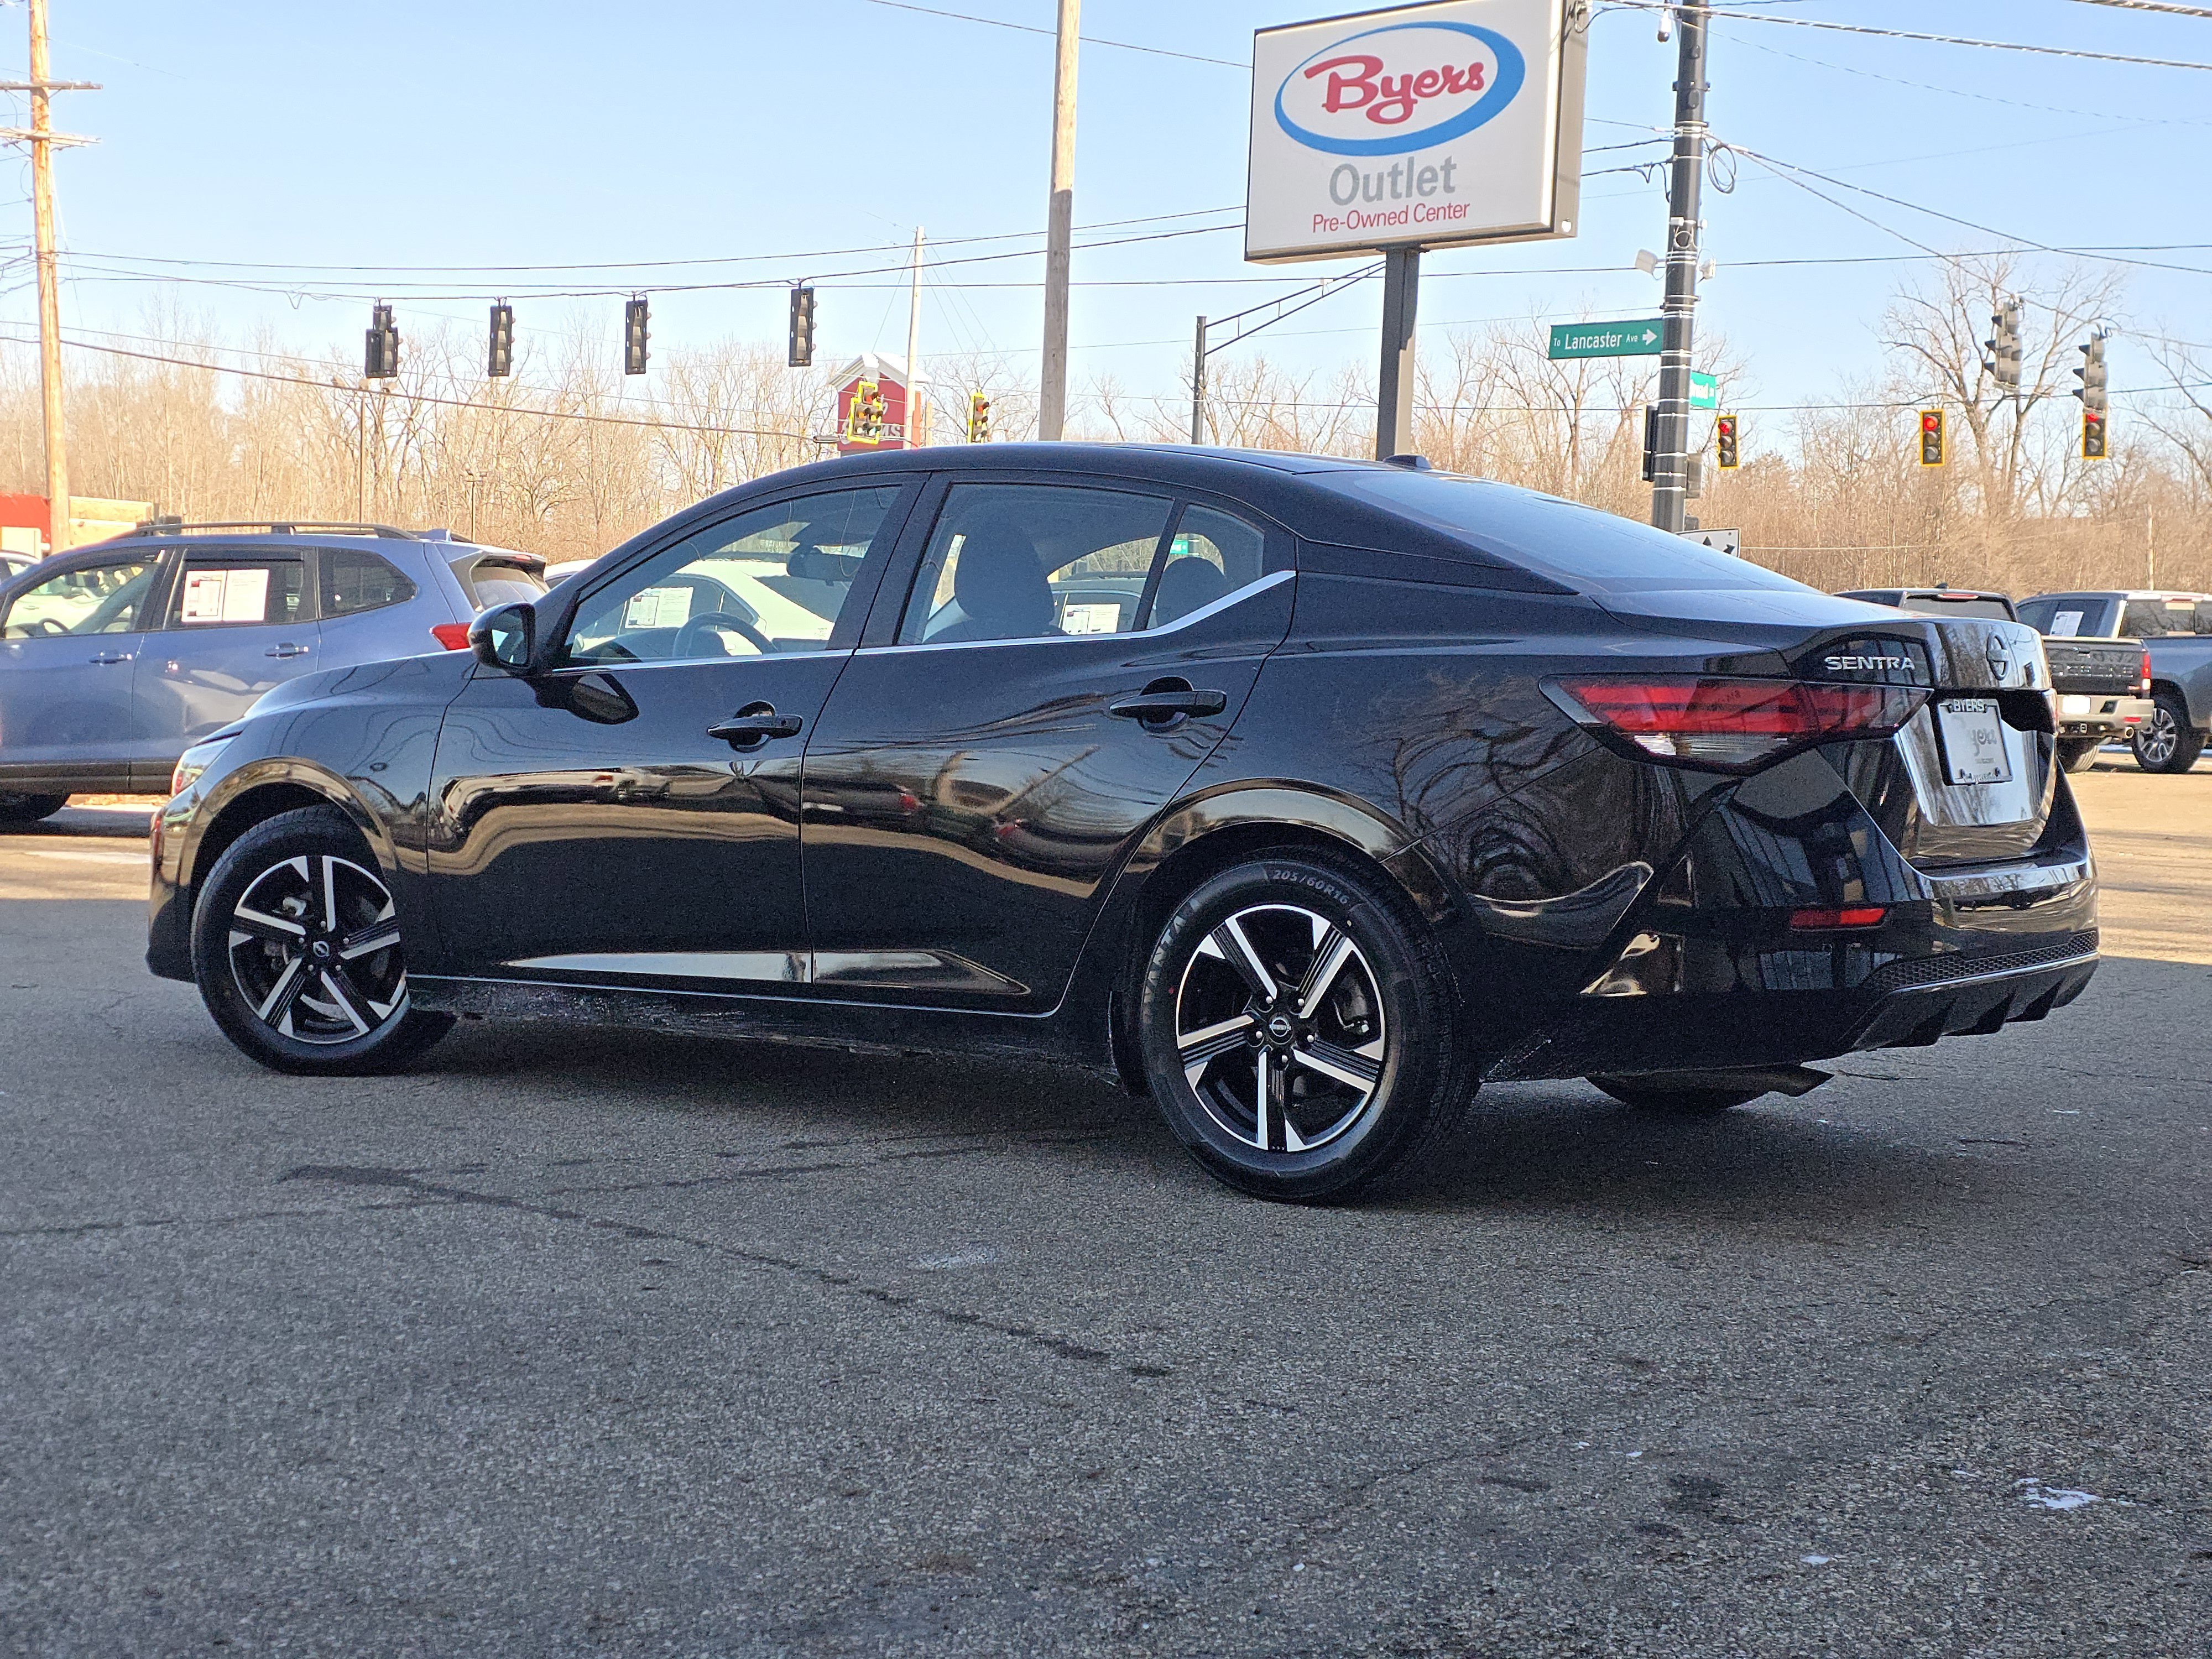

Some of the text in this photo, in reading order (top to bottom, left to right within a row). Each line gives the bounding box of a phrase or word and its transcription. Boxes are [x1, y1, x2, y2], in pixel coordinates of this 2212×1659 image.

[1304, 55, 1485, 124] Byers
[1329, 156, 1457, 206] Outlet
[1312, 201, 1470, 233] Pre-Owned Center
[1553, 331, 1639, 350] To Lancaster Ave
[1824, 656, 1916, 670] SENTRA
[1953, 698, 1984, 712] BYERS
[1272, 869, 1350, 905] 205/60R16
